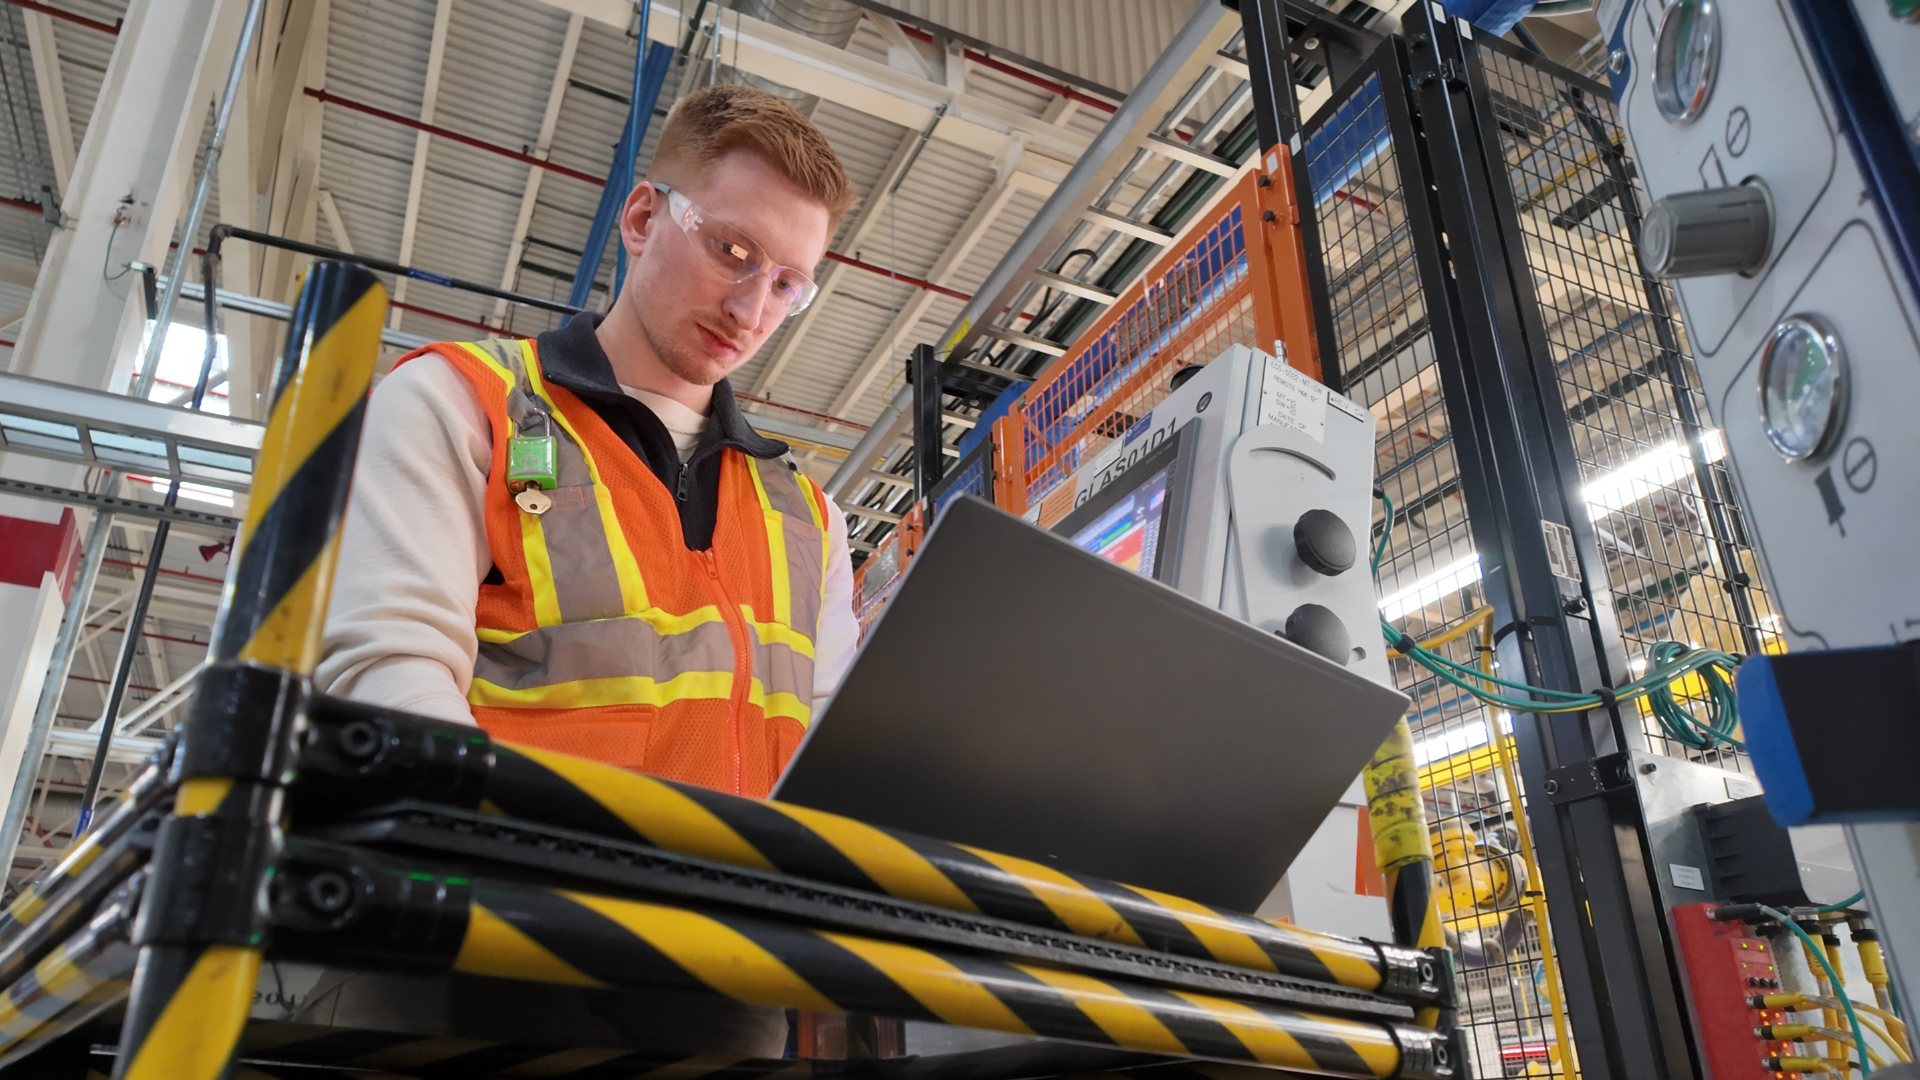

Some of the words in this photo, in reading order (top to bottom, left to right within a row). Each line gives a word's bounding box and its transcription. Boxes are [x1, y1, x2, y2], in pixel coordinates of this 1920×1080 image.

[1273, 374, 1296, 392] REMOTE
[1298, 388, 1308, 398] HMI
[1278, 411, 1296, 424] DATE
[1298, 422, 1307, 430] OF
